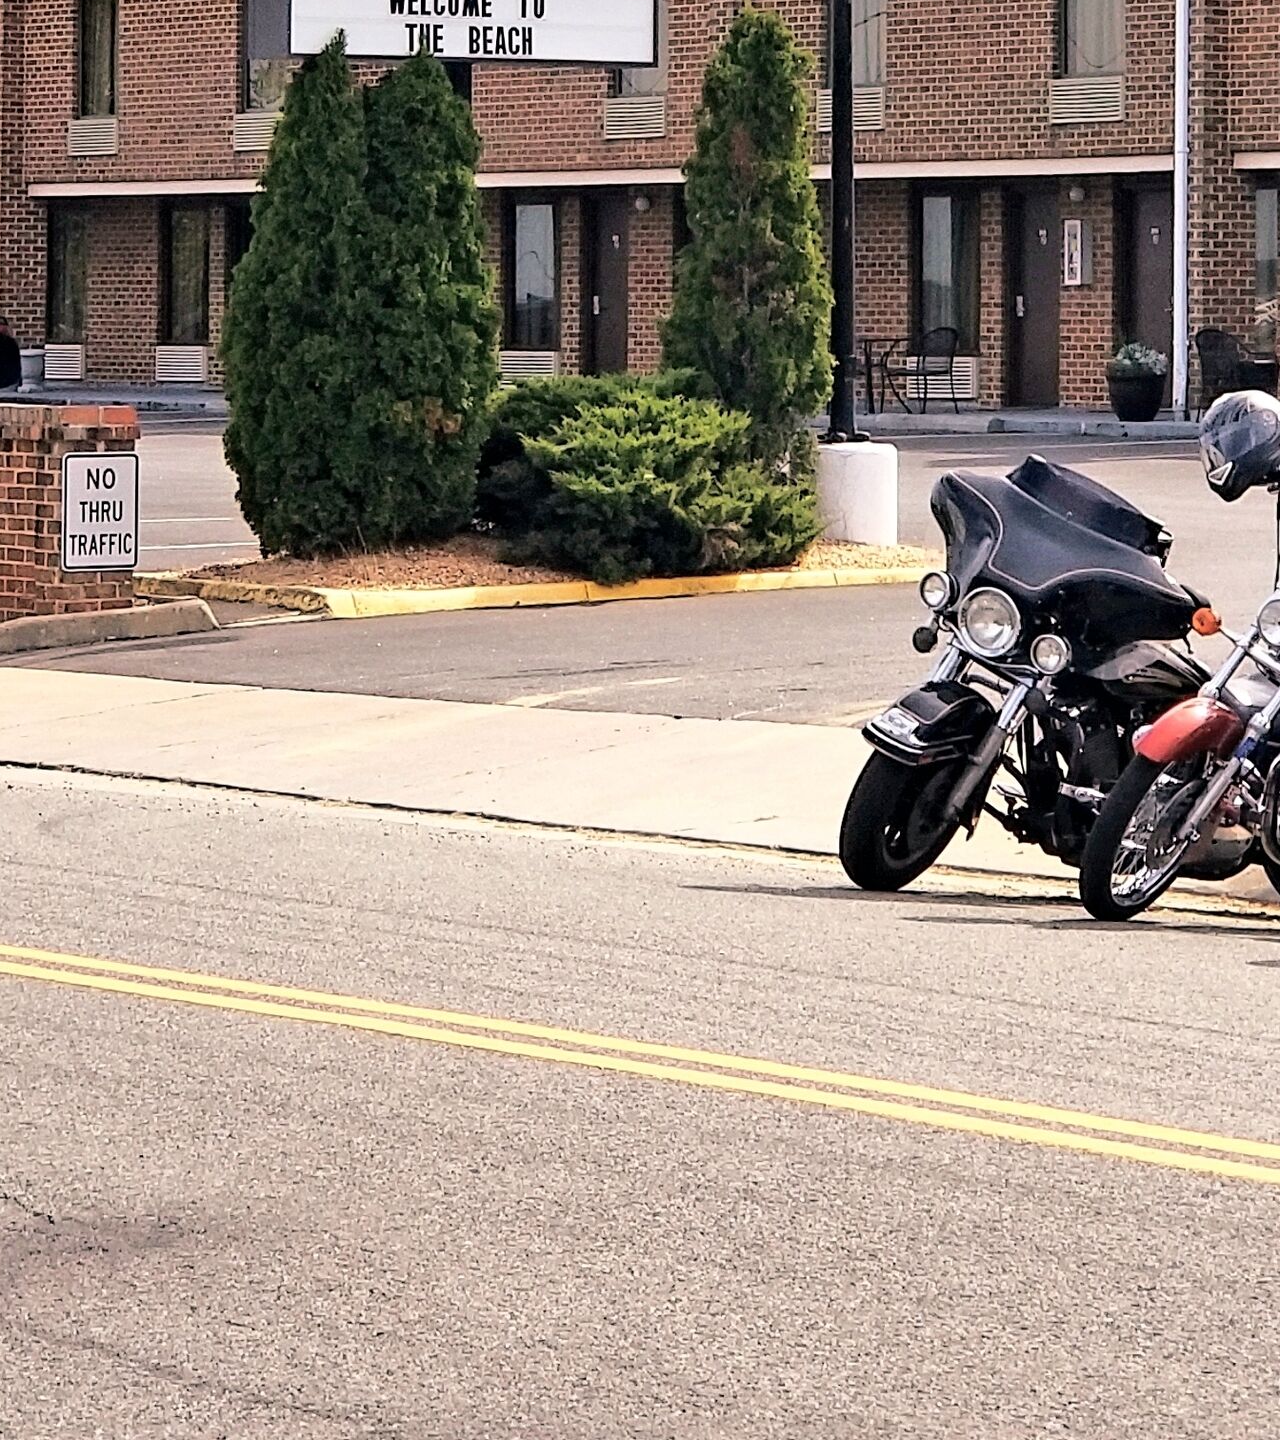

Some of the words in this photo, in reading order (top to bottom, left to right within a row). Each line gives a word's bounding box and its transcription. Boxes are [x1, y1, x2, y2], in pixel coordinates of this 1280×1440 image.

[405, 24, 444, 53] THE
[468, 26, 533, 55] BEACH
[87, 468, 116, 489] NO
[80, 501, 123, 522] THRU
[69, 534, 132, 555] TRAFFIC
